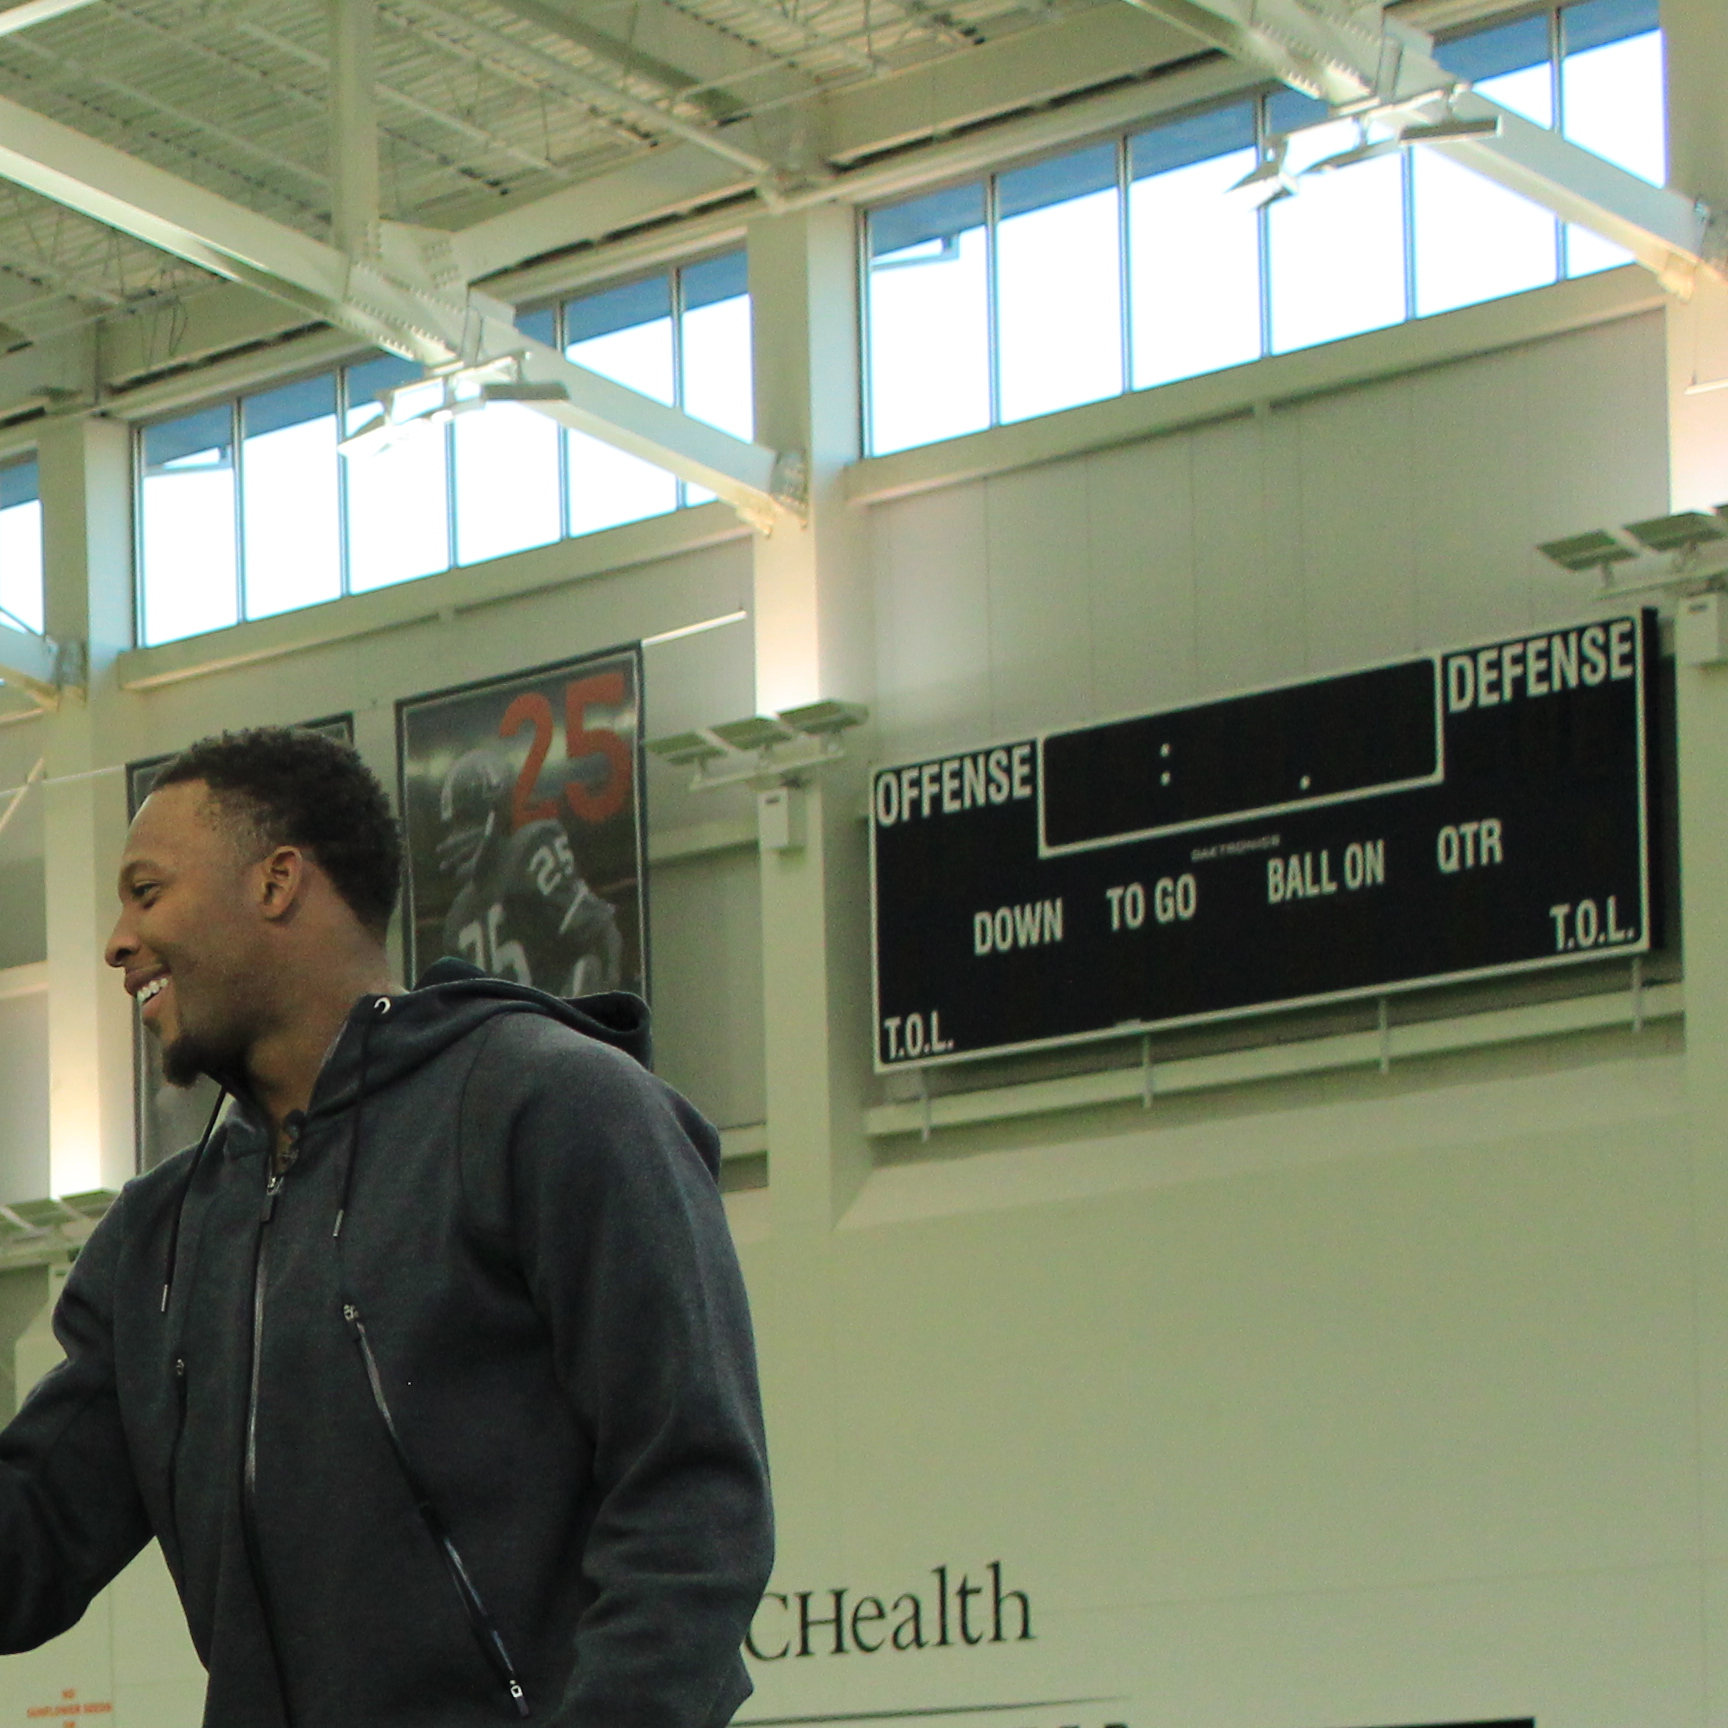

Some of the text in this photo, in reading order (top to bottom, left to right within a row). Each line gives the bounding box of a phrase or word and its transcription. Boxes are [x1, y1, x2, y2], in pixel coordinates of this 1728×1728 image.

[1448, 619, 1633, 713] DEFENSE
[499, 672, 632, 831] 25
[876, 744, 1033, 827] OFFENSE
[1267, 841, 1384, 903] BALL ON
[1438, 818, 1502, 875] QTR
[974, 898, 1063, 956] DOWN
[1106, 873, 1197, 931] TO GO
[1550, 896, 1635, 952] T.O.L.
[884, 1012, 955, 1061] T.O.L.
[743, 1559, 1038, 1663] CHealth
